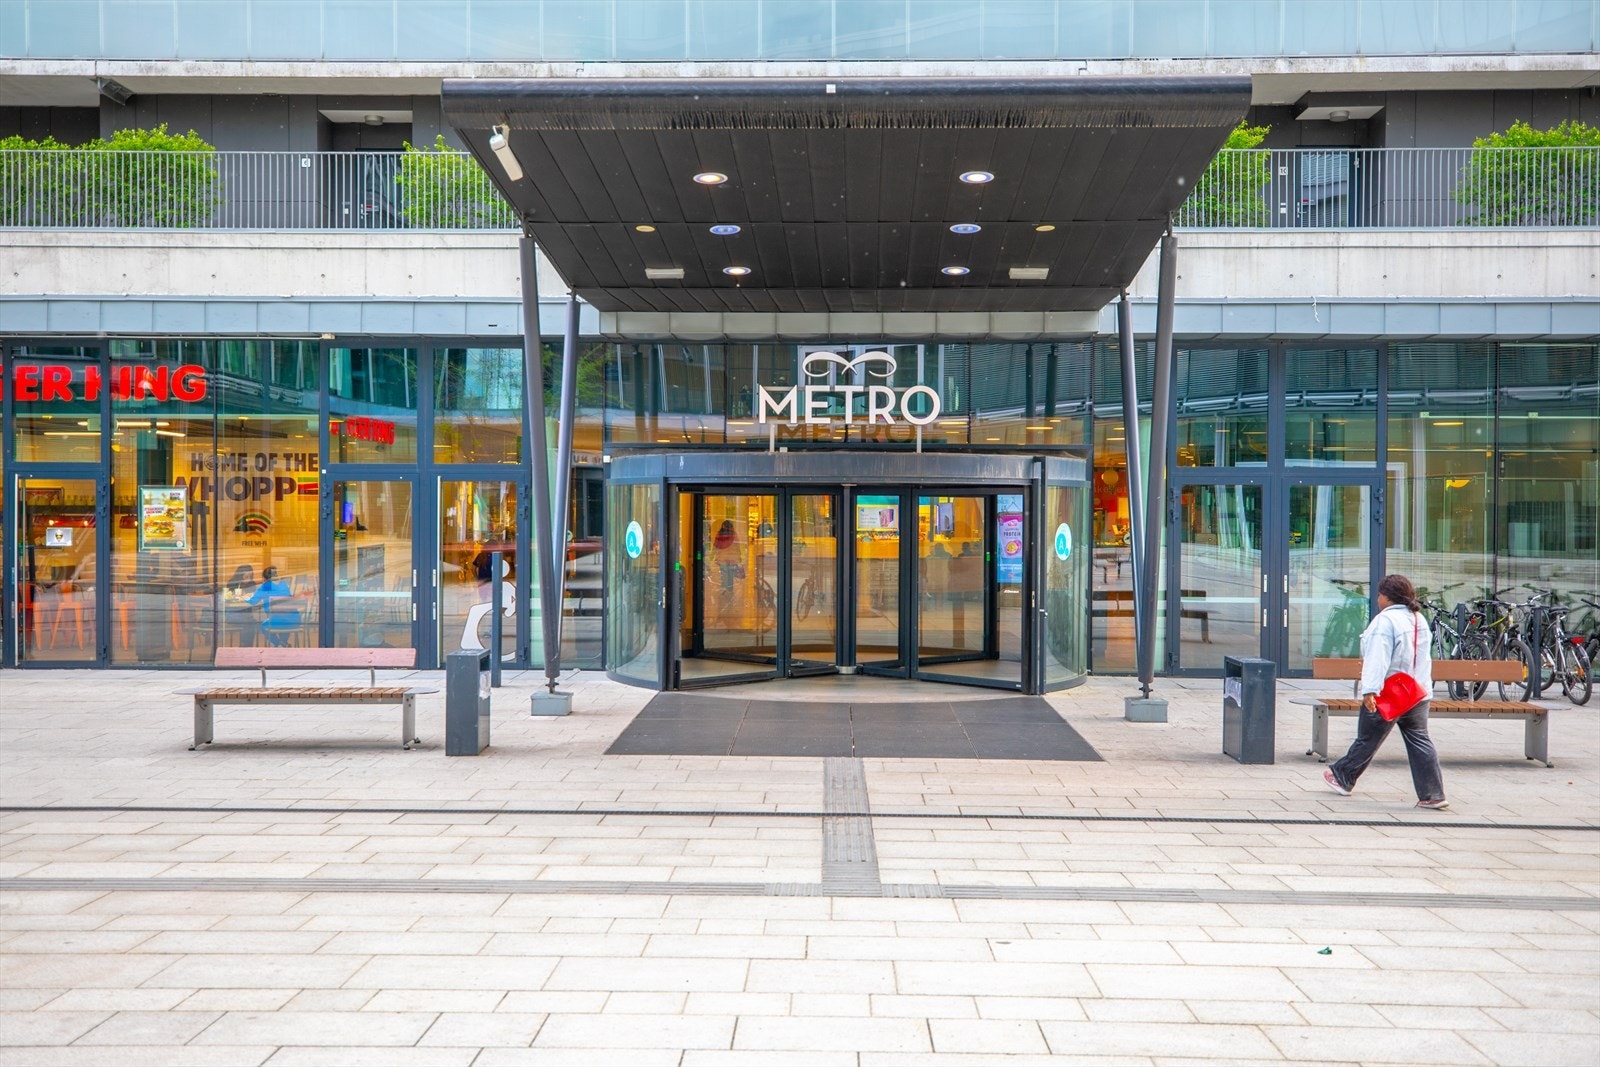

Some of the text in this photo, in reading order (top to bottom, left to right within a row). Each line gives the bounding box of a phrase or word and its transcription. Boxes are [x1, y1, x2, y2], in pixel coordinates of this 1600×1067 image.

[0, 364, 73, 402] ER
[758, 384, 941, 425] METRO
[254, 453, 278, 471] OF
[283, 453, 318, 471] THE
